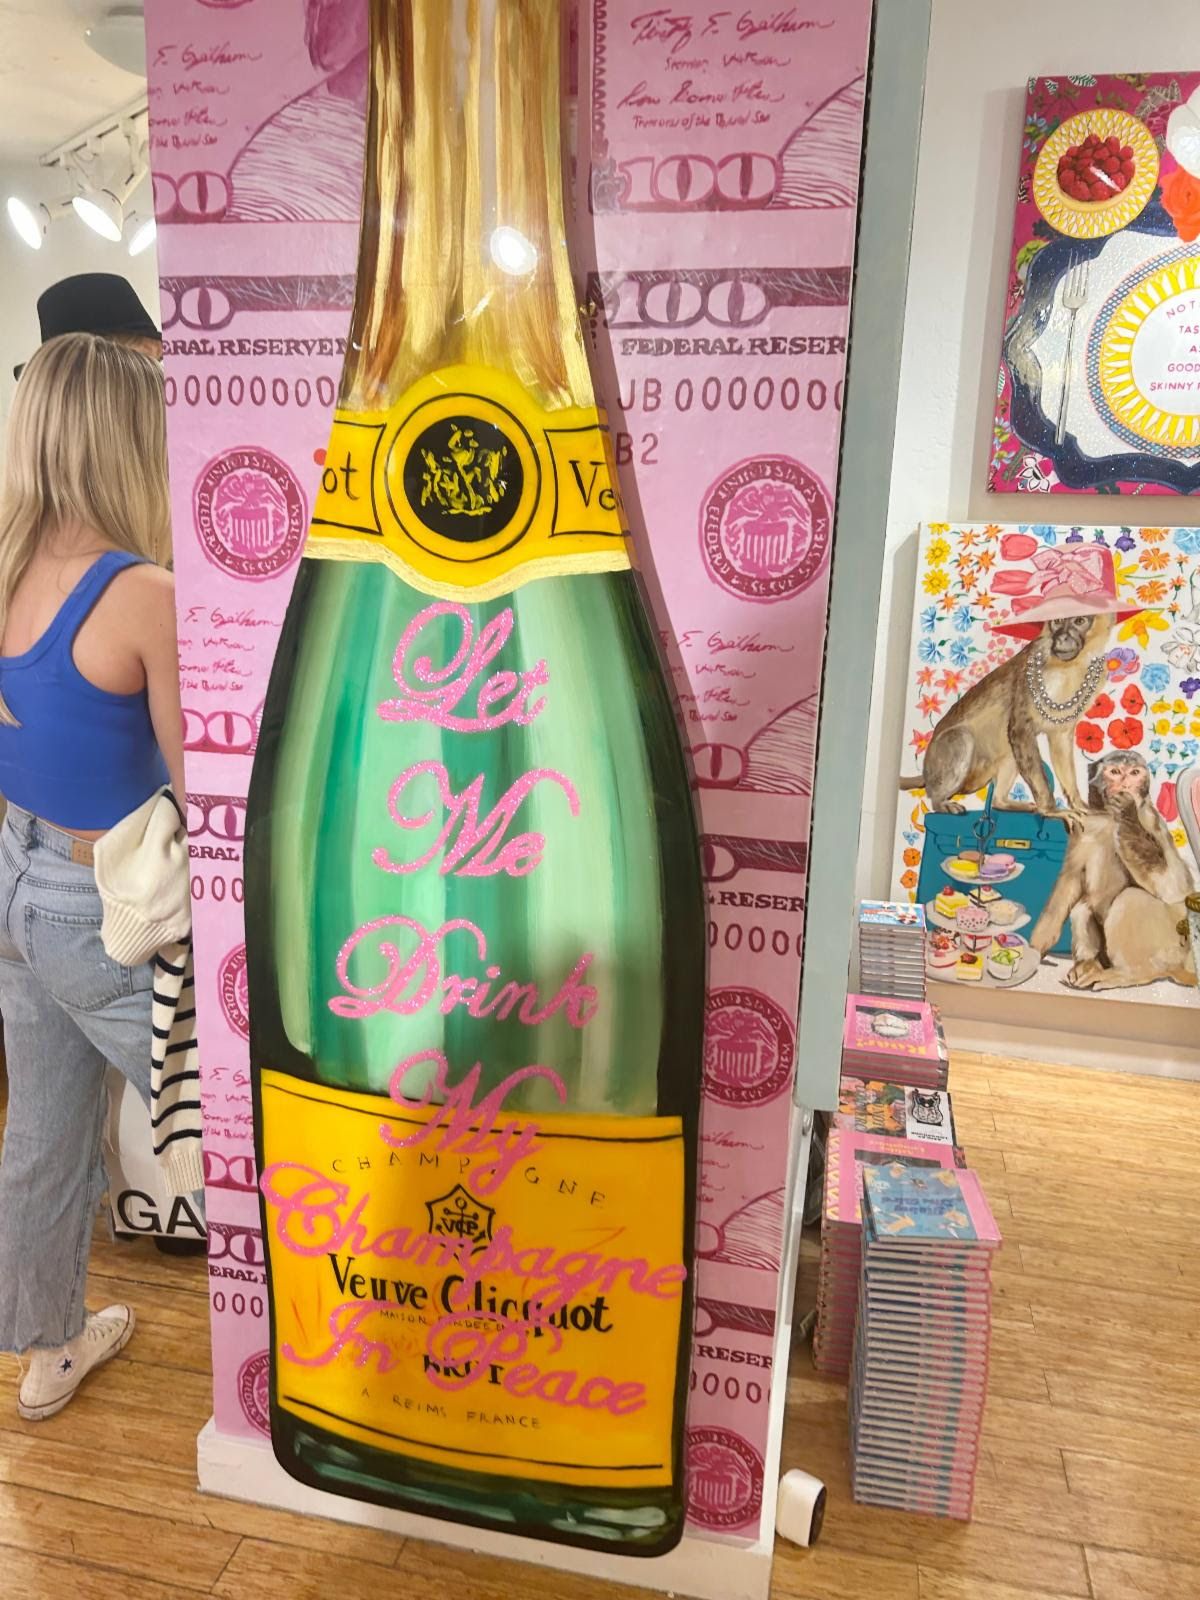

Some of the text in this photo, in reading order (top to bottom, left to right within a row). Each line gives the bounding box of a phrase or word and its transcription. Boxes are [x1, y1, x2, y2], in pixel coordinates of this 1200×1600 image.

[1166, 300, 1200, 319] NOT
[621, 337, 743, 356] FEDERAL
[1167, 362, 1200, 373] GOOD
[1150, 381, 1193, 392] SKINNY
[616, 431, 658, 466] B2
[376, 602, 549, 732] Let
[371, 759, 580, 877] Me
[328, 914, 599, 1029] Drink
[379, 1048, 568, 1197] My
[332, 1151, 605, 1208] CHAMPGNE
[117, 1189, 208, 1238] GA
[259, 1161, 688, 1318] Champagne
[213, 1291, 264, 1319] 000
[328, 1253, 428, 1310] Veuve
[279, 1300, 647, 1417] In Peace
[466, 1410, 541, 1428] FRANCE
